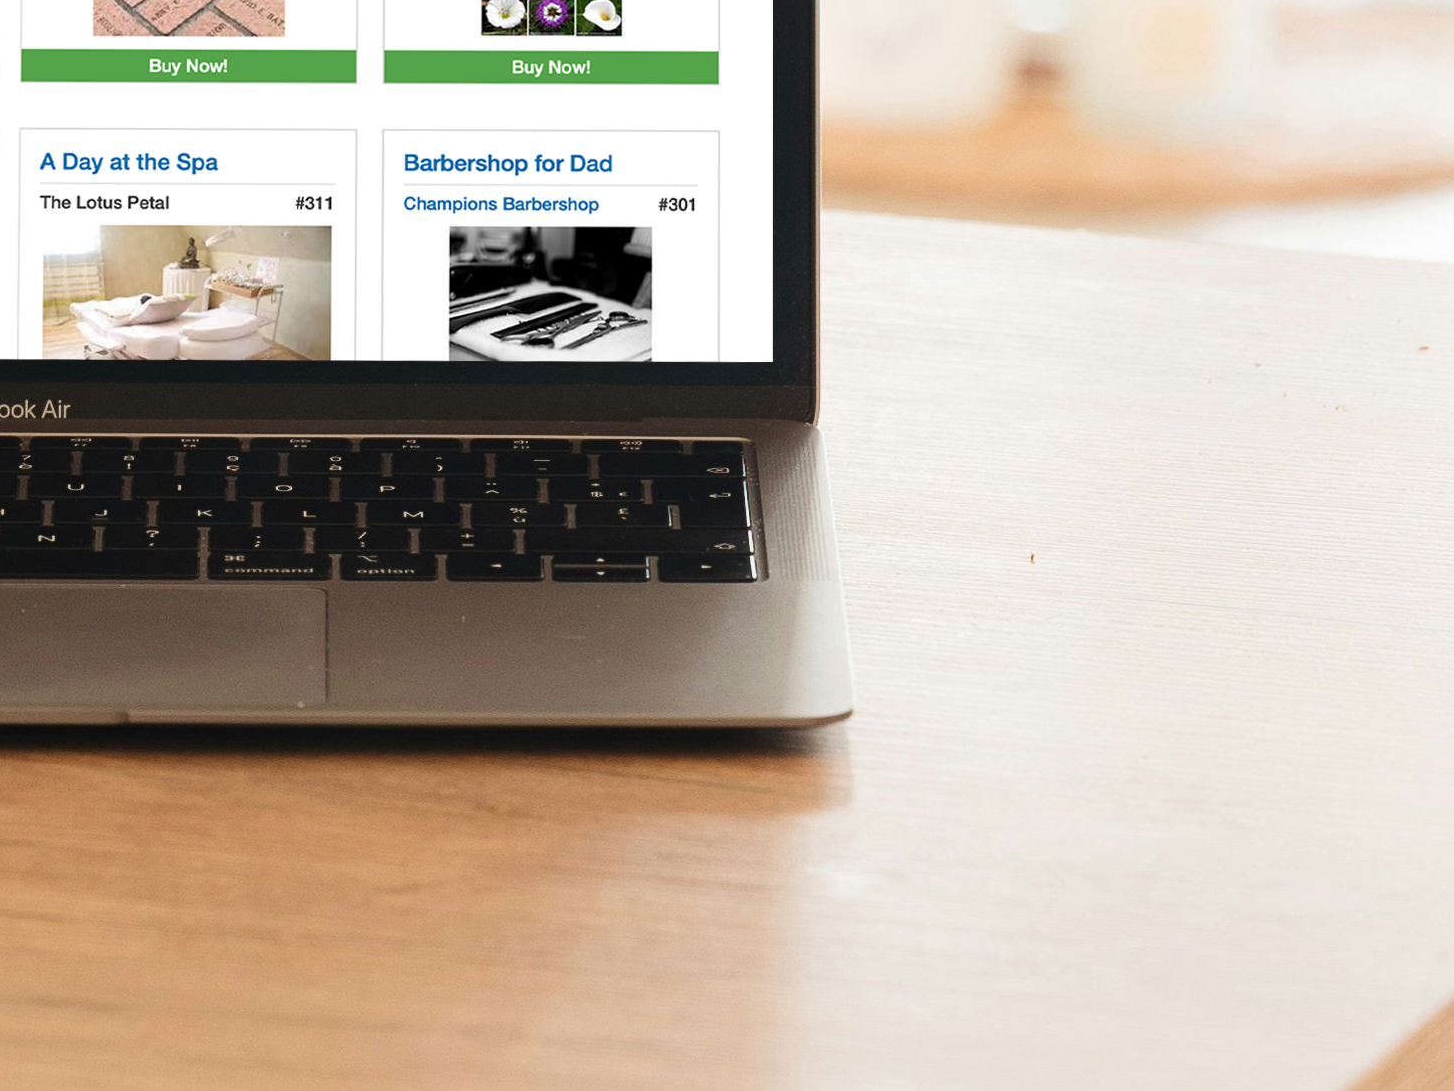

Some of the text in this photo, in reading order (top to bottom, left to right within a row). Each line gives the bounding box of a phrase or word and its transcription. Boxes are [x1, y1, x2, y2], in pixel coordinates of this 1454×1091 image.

[150, 59, 227, 76] Buy Now!
[513, 60, 590, 77] Buy Now!
[40, 152, 218, 175] A Day at the Spa
[405, 154, 612, 176] Barbershop for Dad
[40, 195, 169, 209] The Lotus Petal
[296, 196, 332, 210] #311
[404, 196, 599, 214] Champions Barbershop
[659, 198, 694, 211] #301
[42, 400, 70, 418] Air
